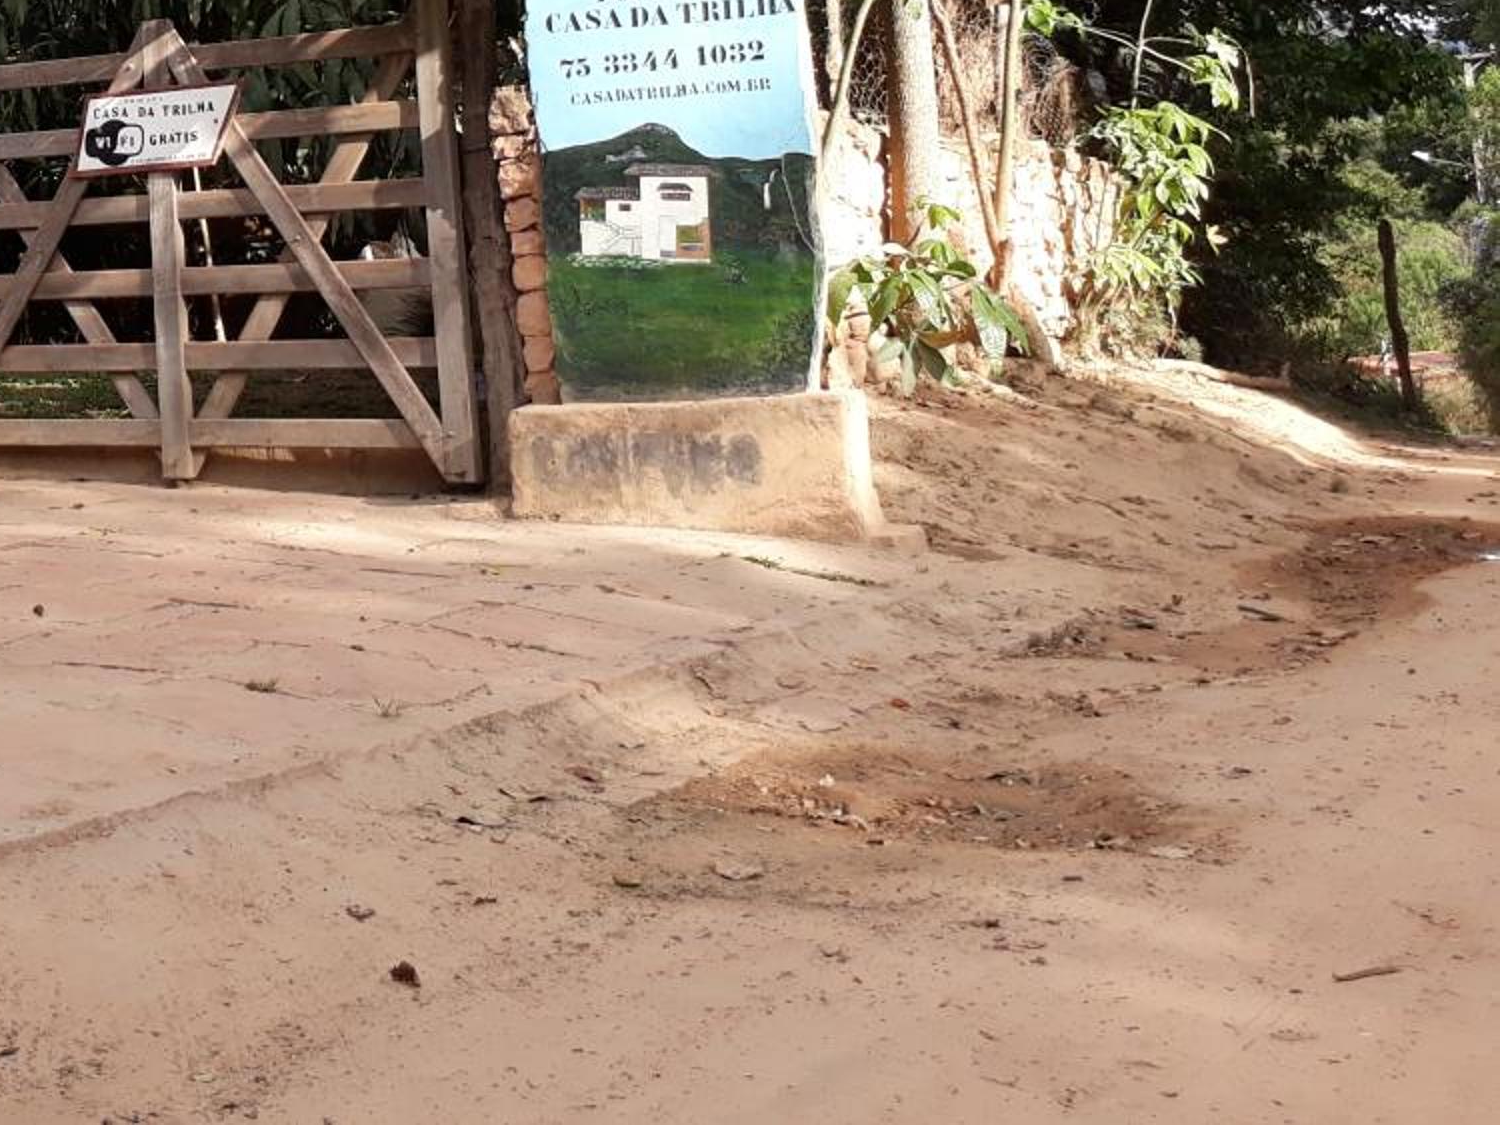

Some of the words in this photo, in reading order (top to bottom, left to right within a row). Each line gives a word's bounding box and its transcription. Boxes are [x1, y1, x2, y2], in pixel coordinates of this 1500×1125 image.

[545, 8, 622, 33] CASA
[631, 6, 669, 28] DA
[560, 58, 591, 79] 75
[603, 48, 679, 74] 3344
[697, 39, 766, 66] 1032
[93, 106, 129, 119] CASA
[137, 106, 155, 117] DA
[162, 101, 215, 117] TRILHA
